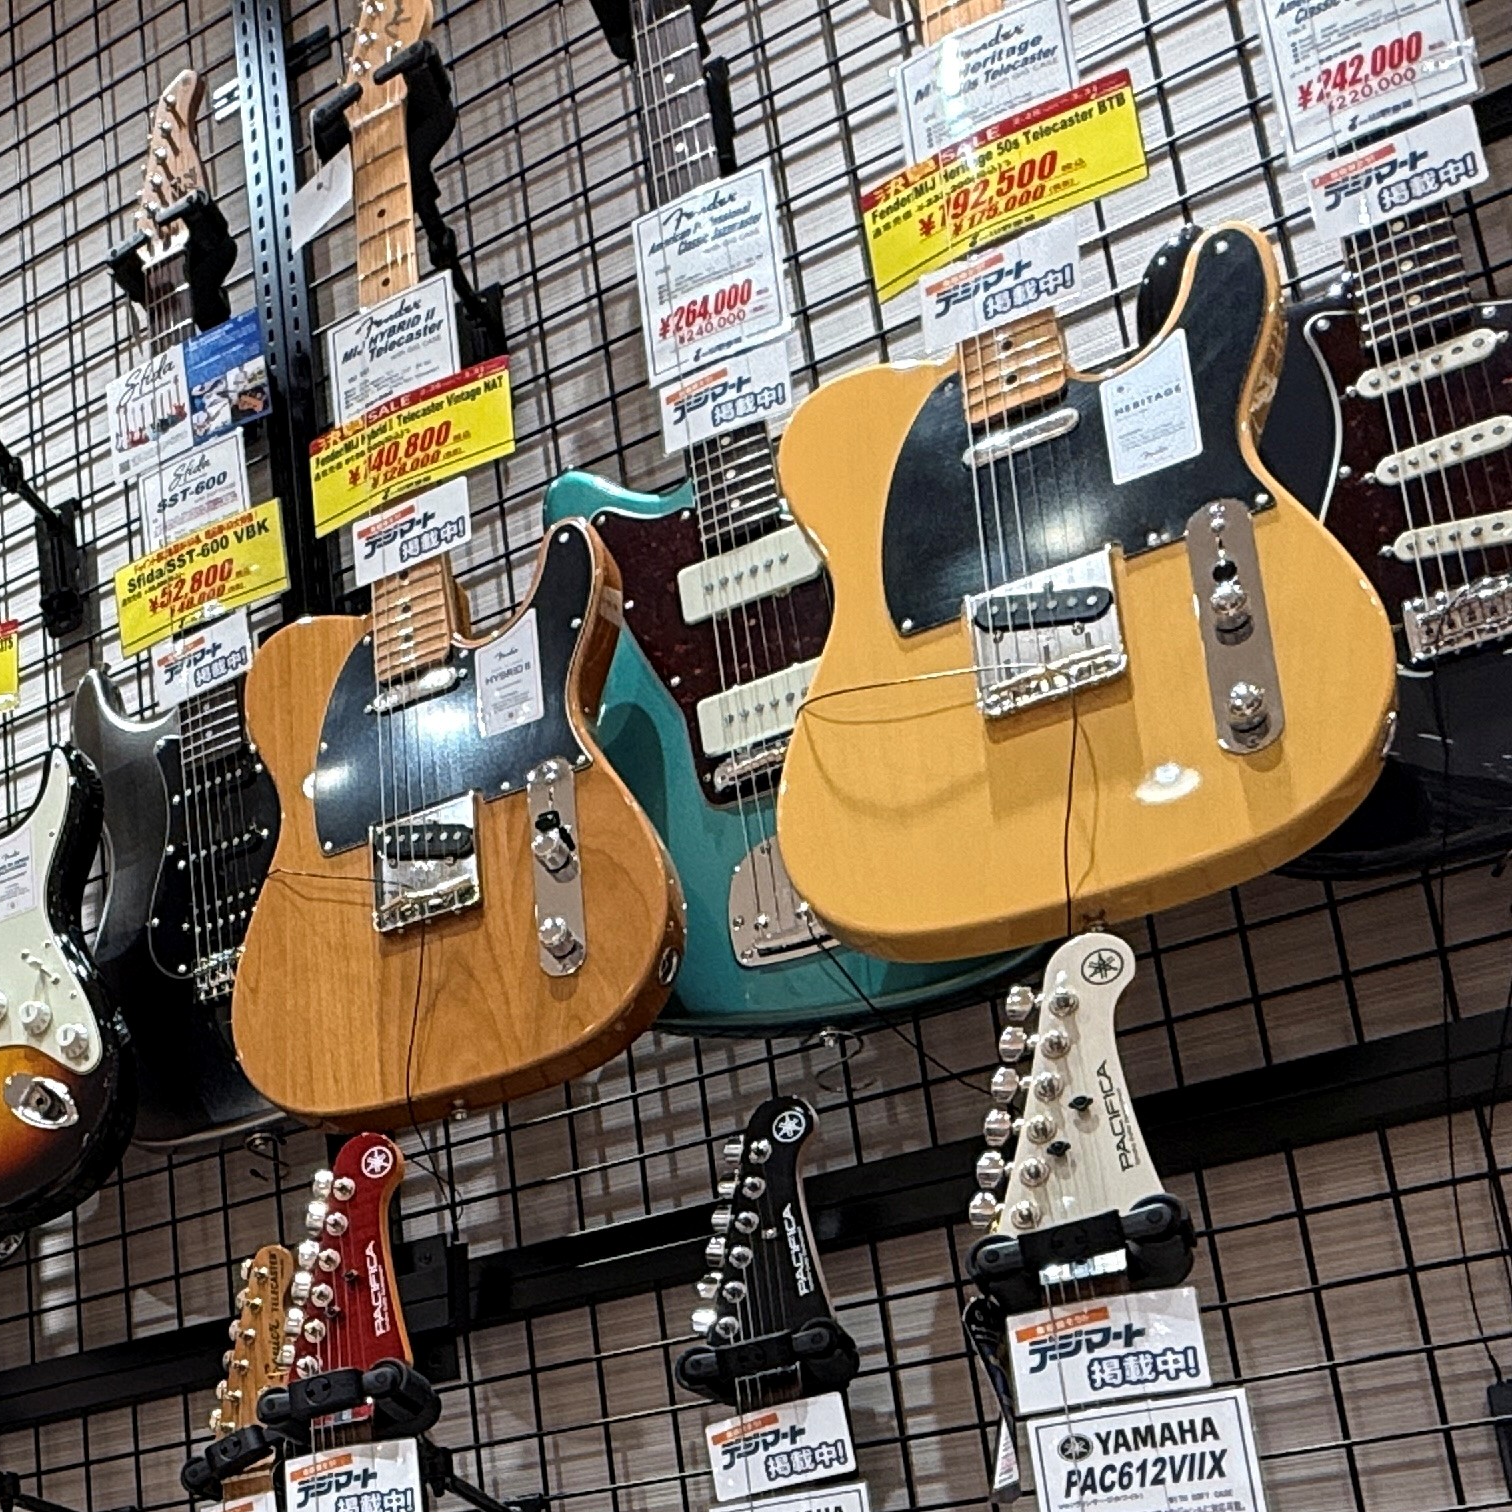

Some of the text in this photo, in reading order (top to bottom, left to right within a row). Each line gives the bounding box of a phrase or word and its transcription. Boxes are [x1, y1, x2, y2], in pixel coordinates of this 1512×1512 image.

[983, 44, 1059, 85] Telecaster
[1298, 30, 1423, 111] ¥242,000
[1023, 108, 1096, 145] Telecaster
[1097, 91, 1127, 116] BTB
[1324, 150, 1429, 212] デジマート
[658, 278, 753, 340] ¥264,000
[935, 258, 1032, 319] デジマート
[366, 311, 420, 346] HYBRID
[367, 317, 444, 364] Telecaster
[367, 395, 411, 424] SALE
[157, 470, 229, 515] SST-600
[127, 516, 270, 595] Sfida/SST-600 VBK
[148, 558, 235, 615] ¥52,800
[1096, 1059, 1130, 1173] PACIFICA
[1029, 1323, 1146, 1374] デジマート
[1088, 1345, 1201, 1391] 掲載中!
[721, 1424, 807, 1472] デジマート
[1094, 1416, 1220, 1456] YAMAHA
[297, 1467, 378, 1509] デジマート
[1064, 1448, 1228, 1499] PAC612VIIX
